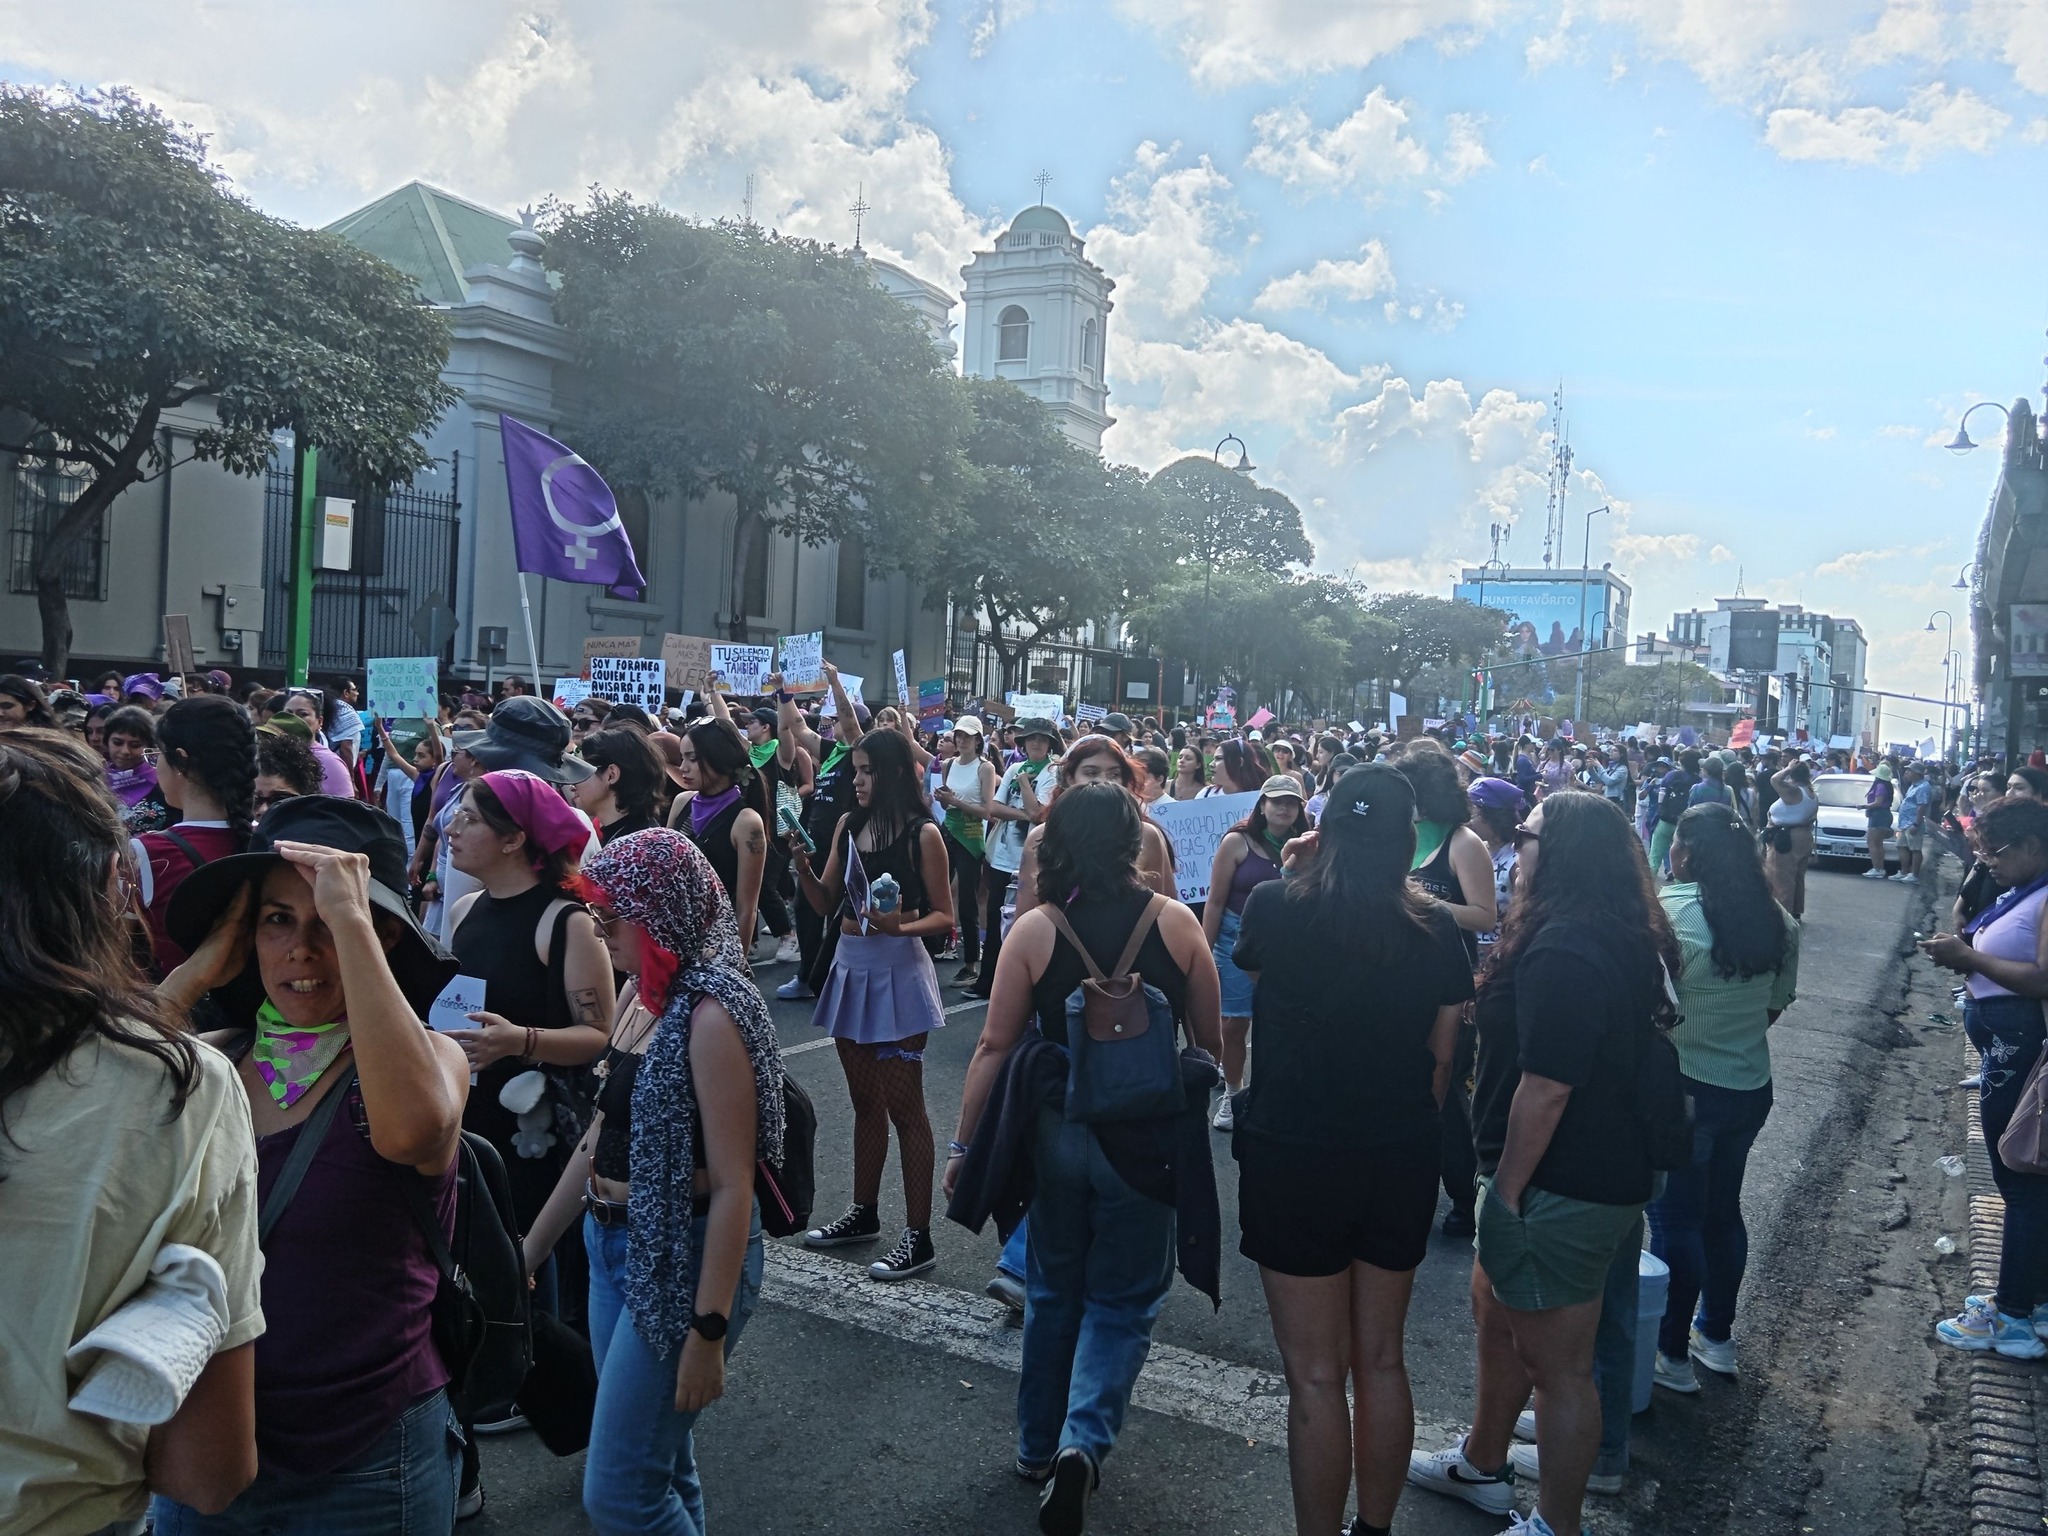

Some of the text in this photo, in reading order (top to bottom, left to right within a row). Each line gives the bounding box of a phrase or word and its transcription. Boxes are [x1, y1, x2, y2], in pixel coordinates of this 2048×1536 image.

[586, 640, 616, 650] NUNCA
[715, 647, 731, 661] TU
[731, 647, 770, 662] SILENCIO
[407, 662, 421, 675] LAS
[592, 658, 610, 669] SOY
[724, 662, 759, 676] TAMBIEN
[414, 675, 425, 687] NO
[592, 669, 627, 682] ¿QUIEN
[629, 672, 642, 682] LE
[666, 666, 706, 687] MUER
[591, 681, 633, 693] AVISARA
[637, 683, 644, 694] A
[649, 684, 662, 694] MI
[623, 695, 642, 704] QUE
[647, 695, 660, 705] NO
[1166, 815, 1215, 837] MARCHO
[1219, 809, 1242, 832] HOY
[1173, 836, 1206, 858] IGAS
